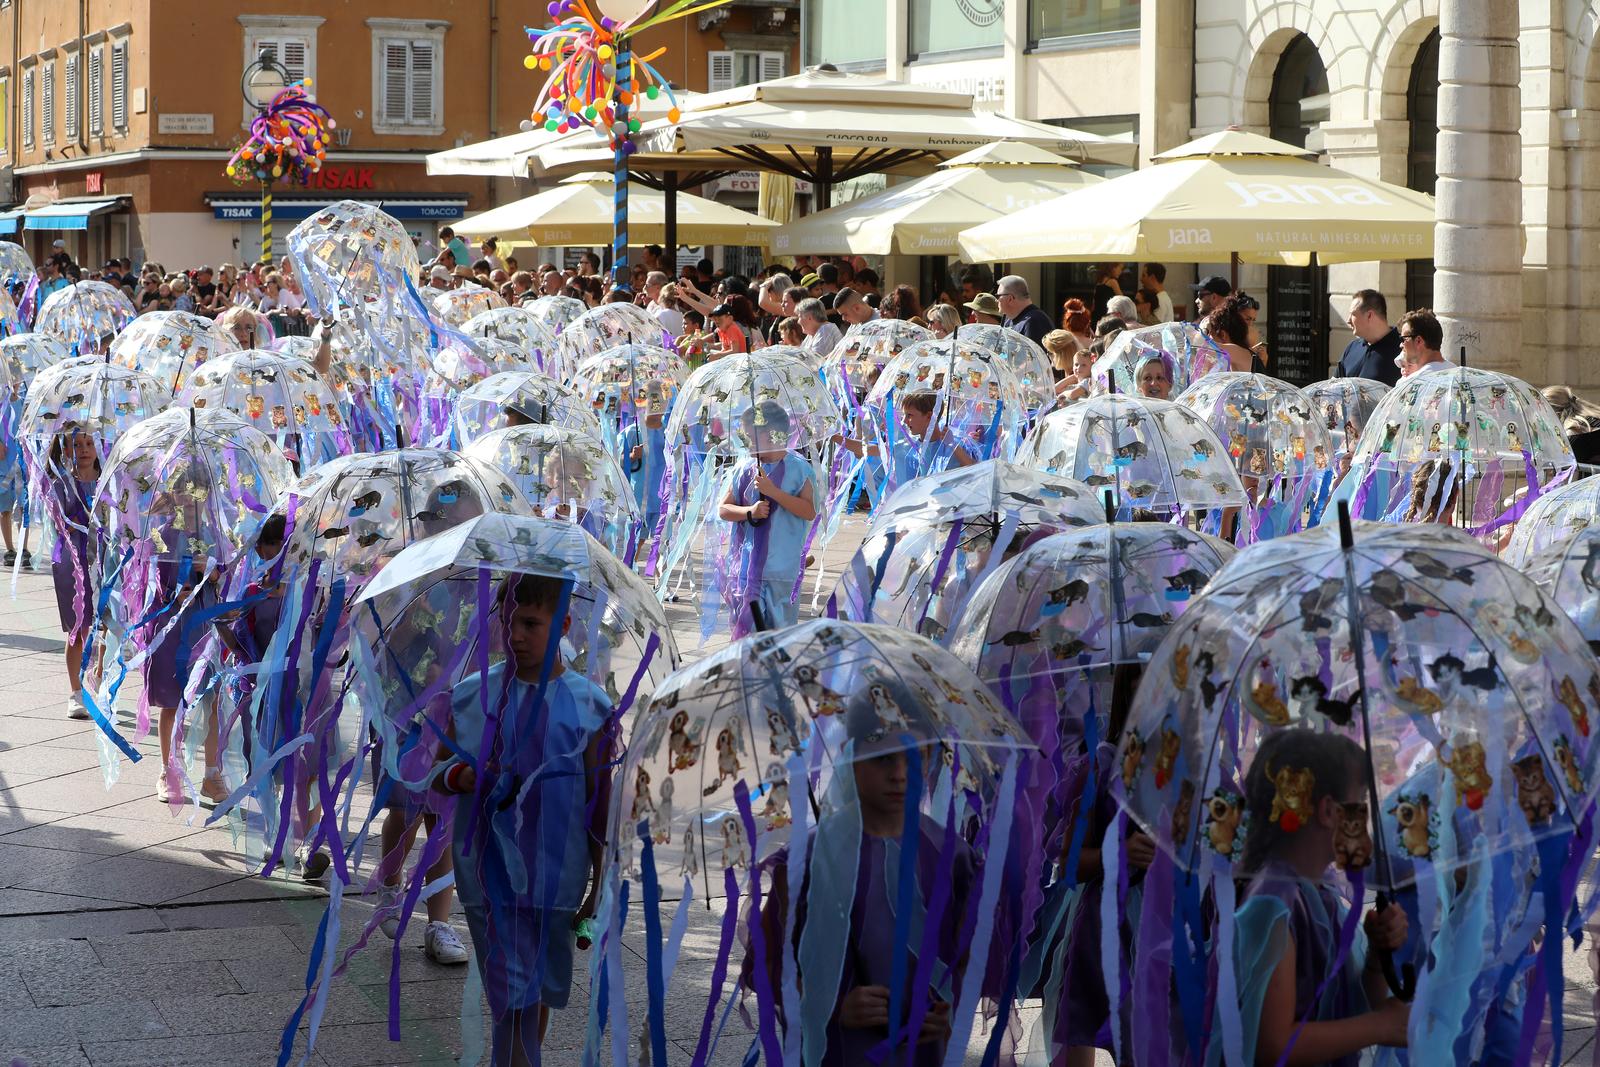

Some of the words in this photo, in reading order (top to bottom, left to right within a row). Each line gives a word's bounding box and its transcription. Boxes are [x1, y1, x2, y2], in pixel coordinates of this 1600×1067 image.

[731, 179, 808, 190] FOTAF
[222, 208, 253, 217] TISAK
[421, 208, 458, 216] TOBACCO
[1256, 231, 1316, 244] NATURAL
[1320, 232, 1376, 245] MINERAL
[1379, 232, 1424, 246] WATER
